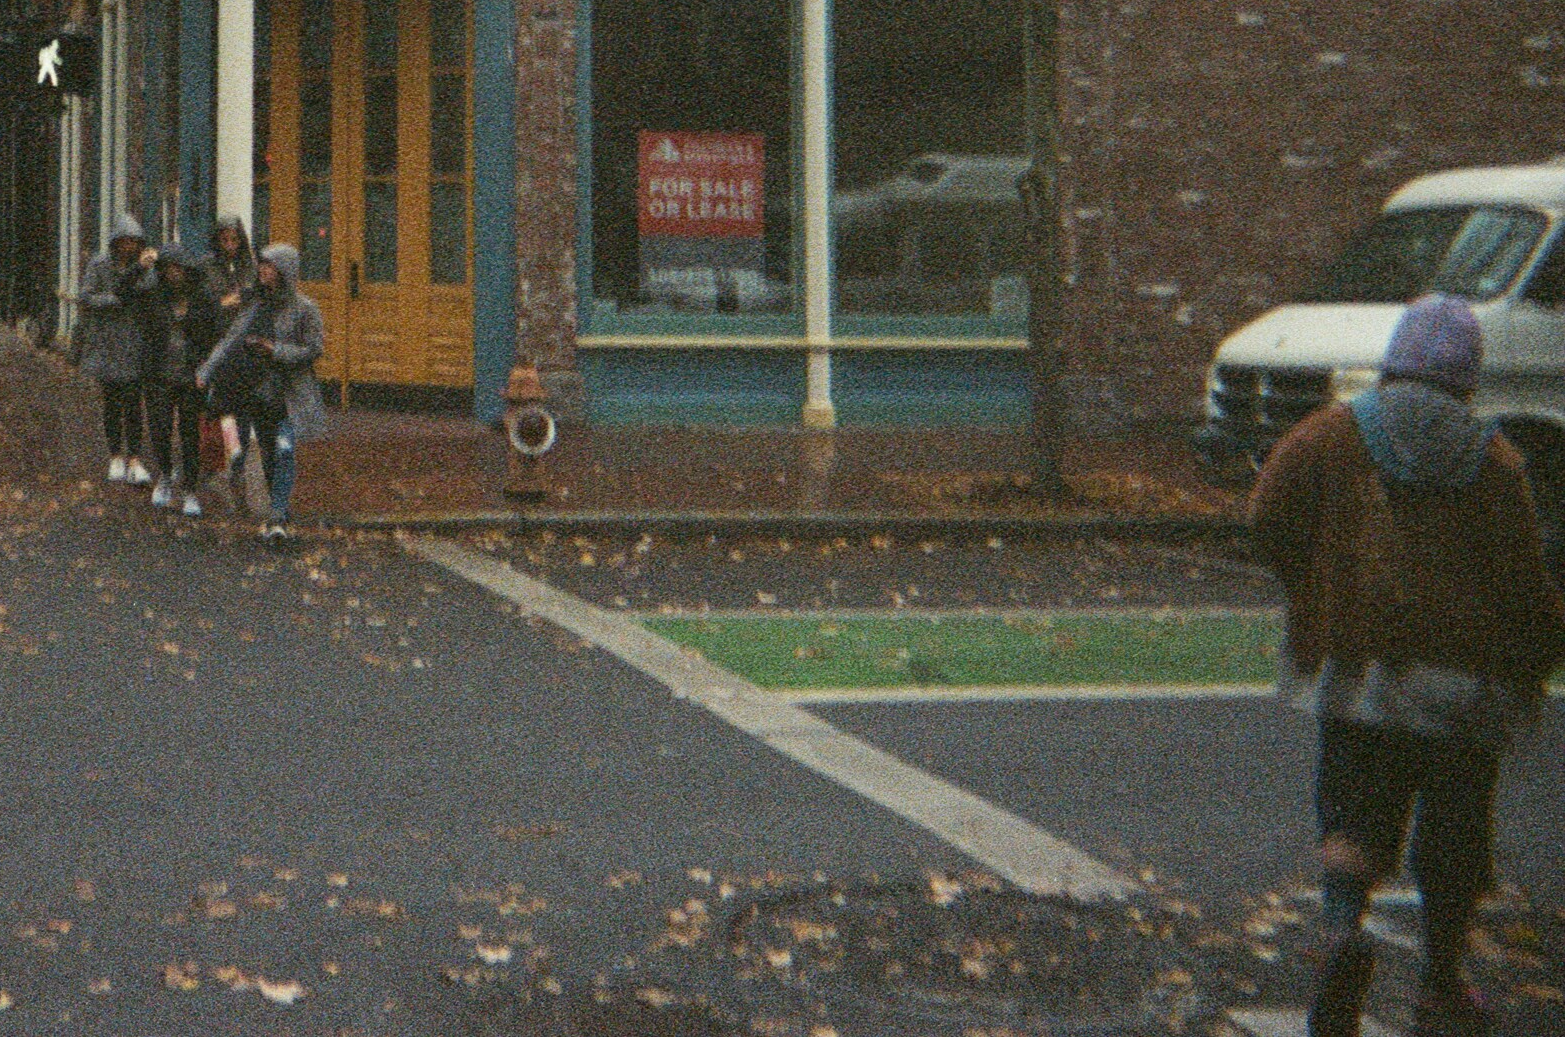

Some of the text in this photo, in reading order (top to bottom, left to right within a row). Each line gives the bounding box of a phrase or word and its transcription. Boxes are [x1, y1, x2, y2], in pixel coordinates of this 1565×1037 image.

[649, 178, 756, 198] FOR SALE
[649, 199, 756, 220] OR LEASE
